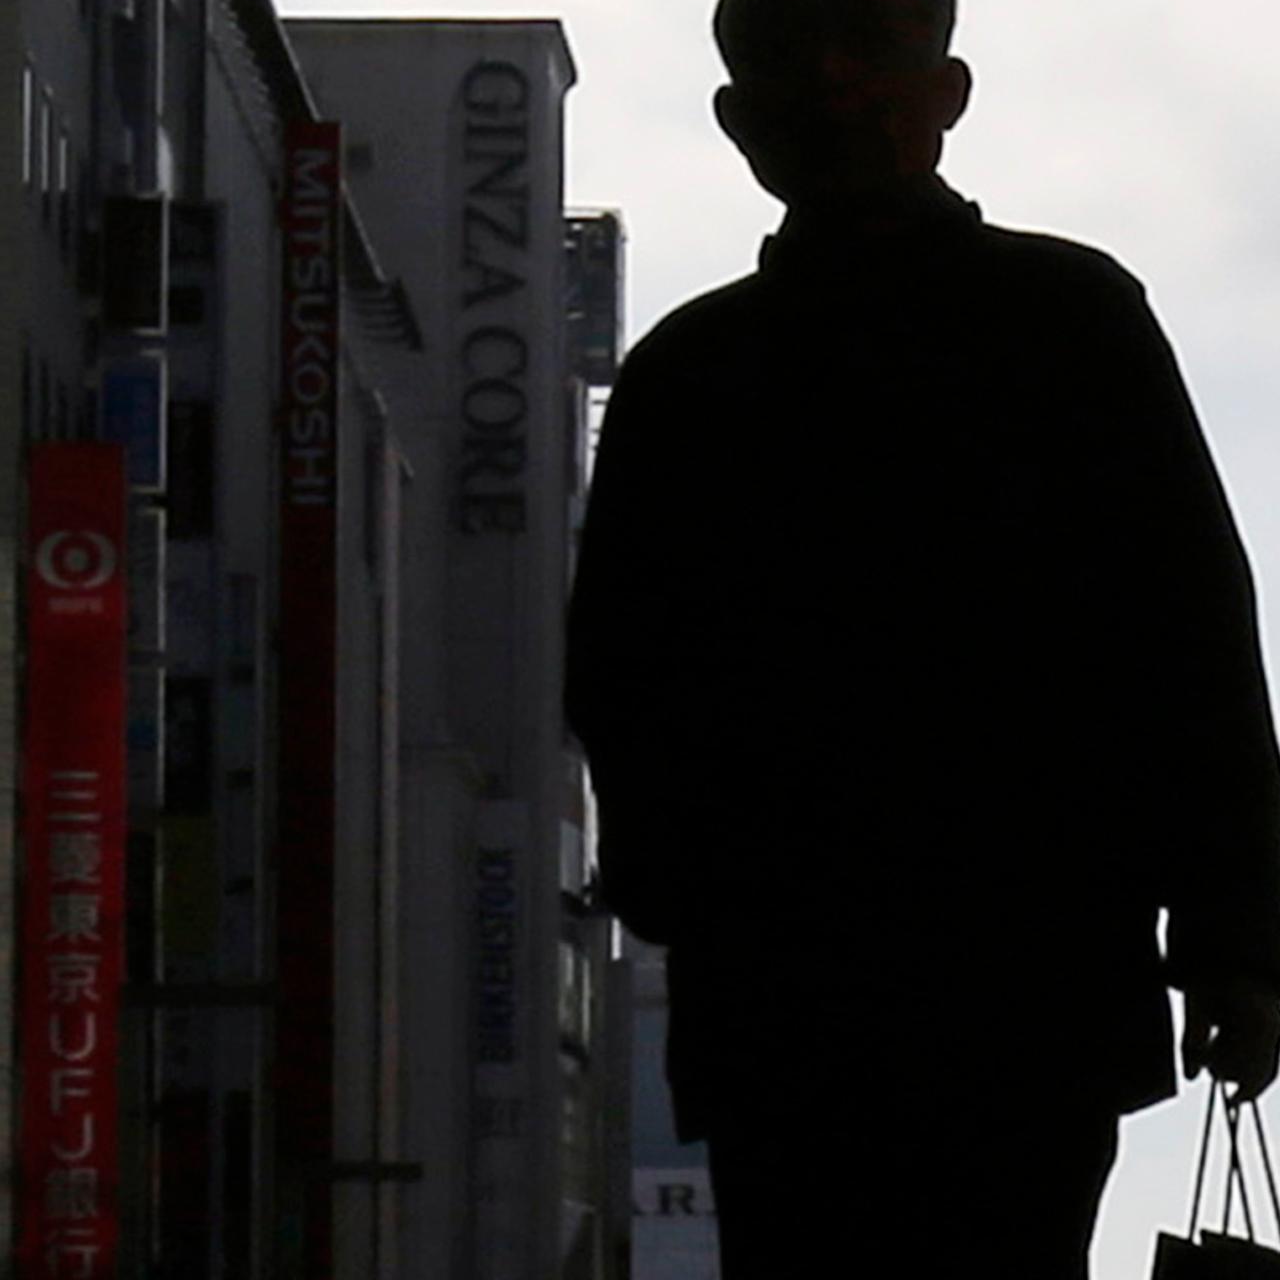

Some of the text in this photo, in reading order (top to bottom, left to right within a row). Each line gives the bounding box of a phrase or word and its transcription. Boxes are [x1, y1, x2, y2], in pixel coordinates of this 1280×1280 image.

[290, 144, 338, 508] MITSUKOSHI
[462, 58, 528, 536] GINZA CORE
